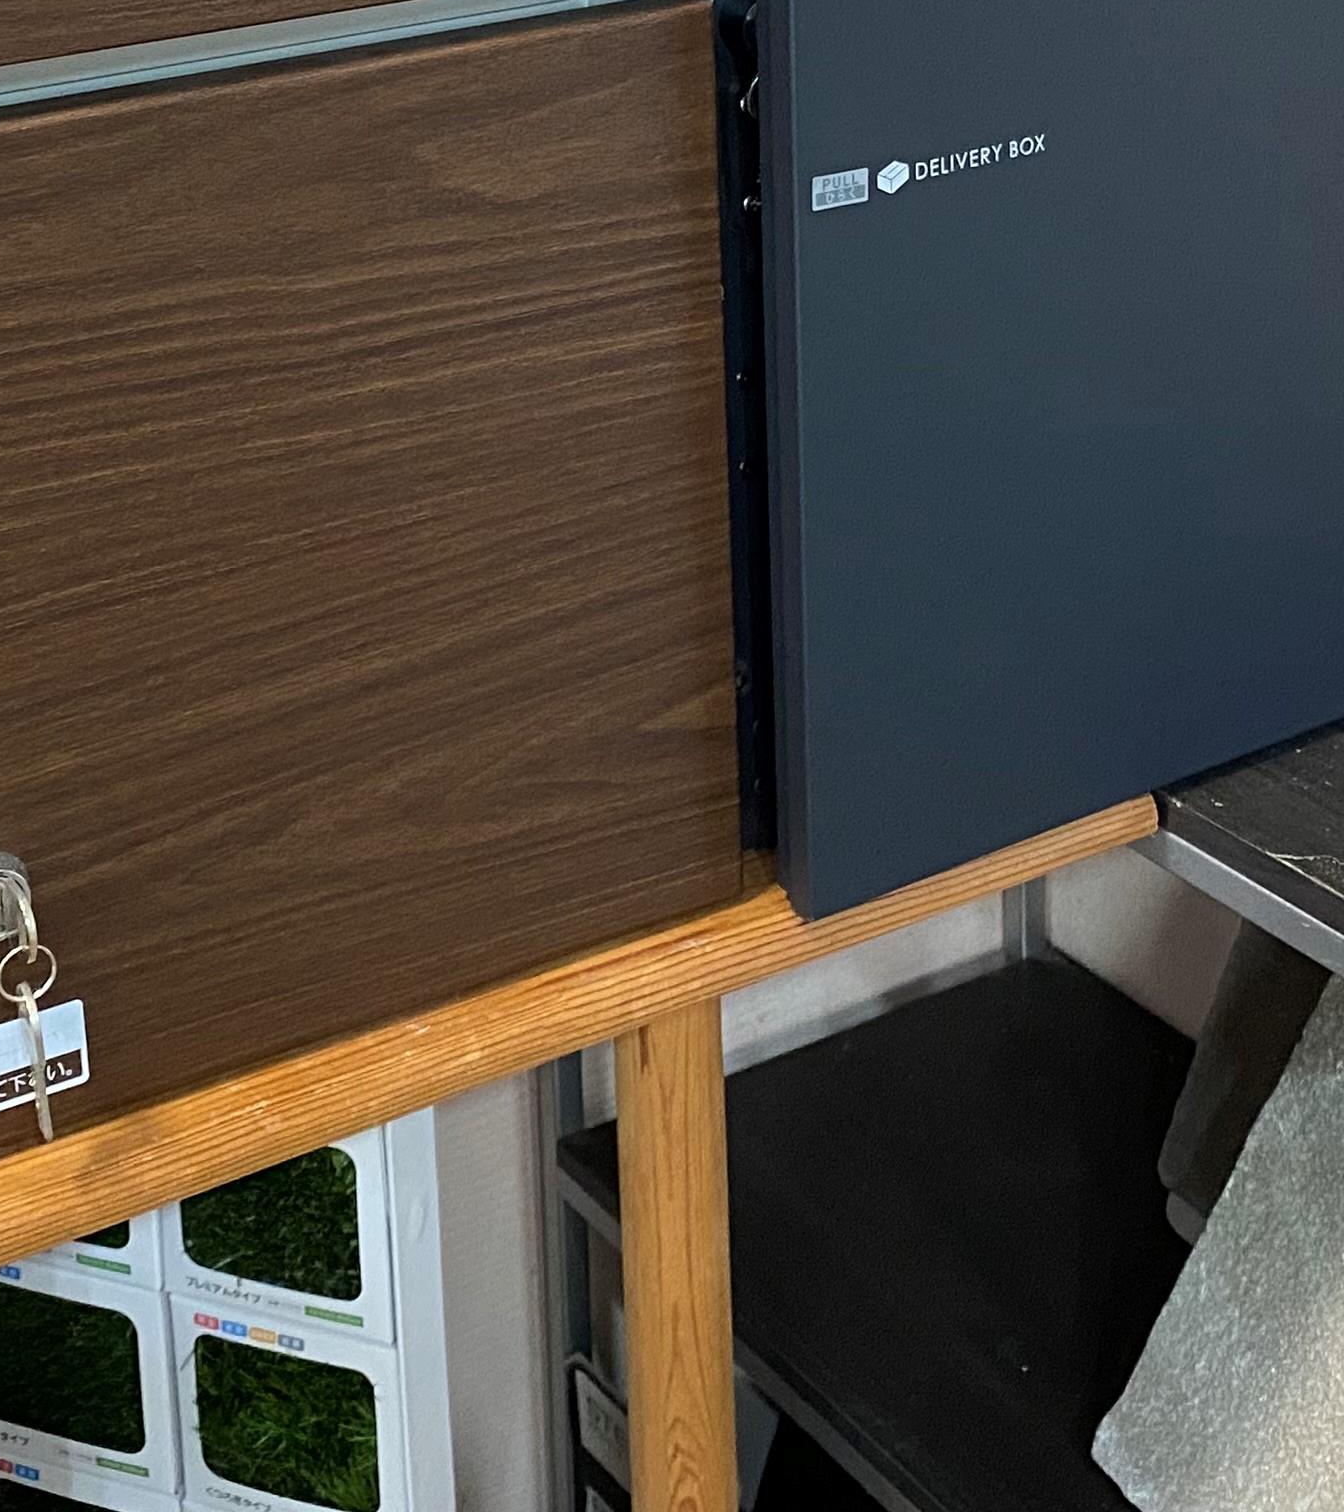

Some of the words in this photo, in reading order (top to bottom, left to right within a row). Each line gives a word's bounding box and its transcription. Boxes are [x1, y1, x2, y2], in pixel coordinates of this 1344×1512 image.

[915, 143, 1003, 181] DELIVERY
[1008, 134, 1046, 160] BOX
[822, 173, 860, 192] PULL
